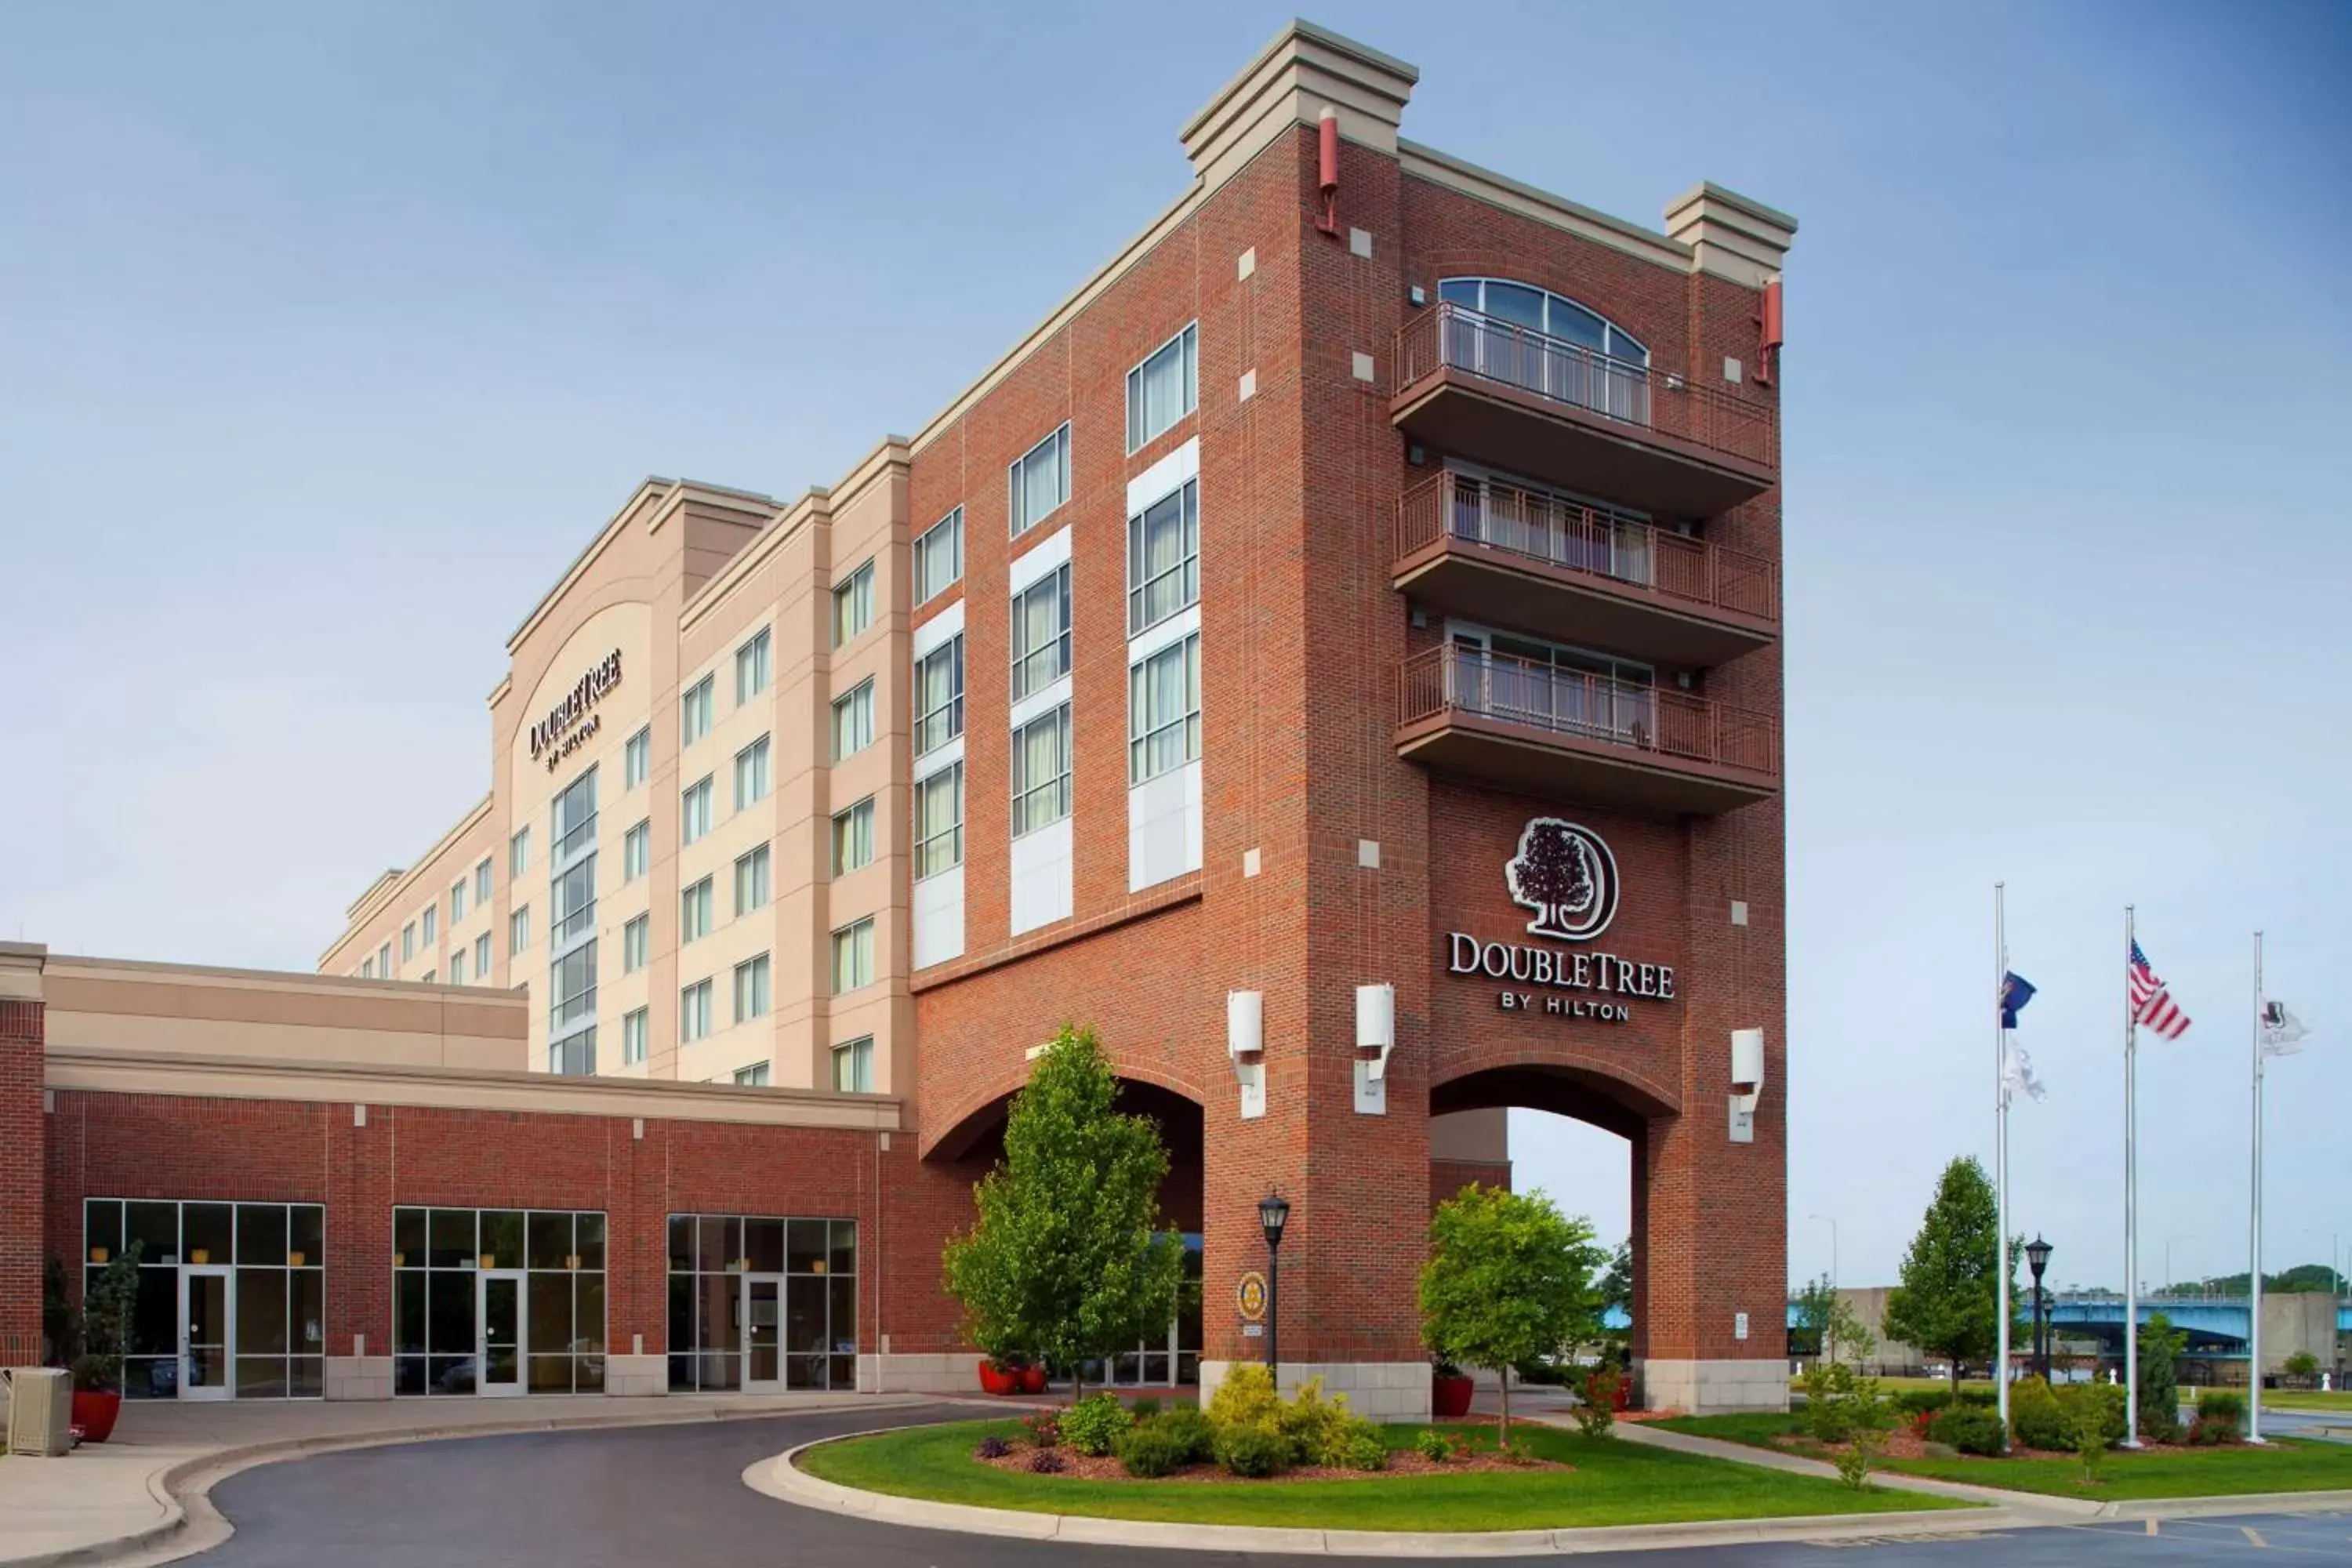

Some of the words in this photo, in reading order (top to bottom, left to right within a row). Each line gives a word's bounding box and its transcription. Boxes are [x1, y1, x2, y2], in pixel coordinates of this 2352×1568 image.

[1449, 932, 1676, 1000] DOUBLETREE
[1501, 991, 1530, 1010] BY
[1547, 997, 1629, 1021] HILTON
